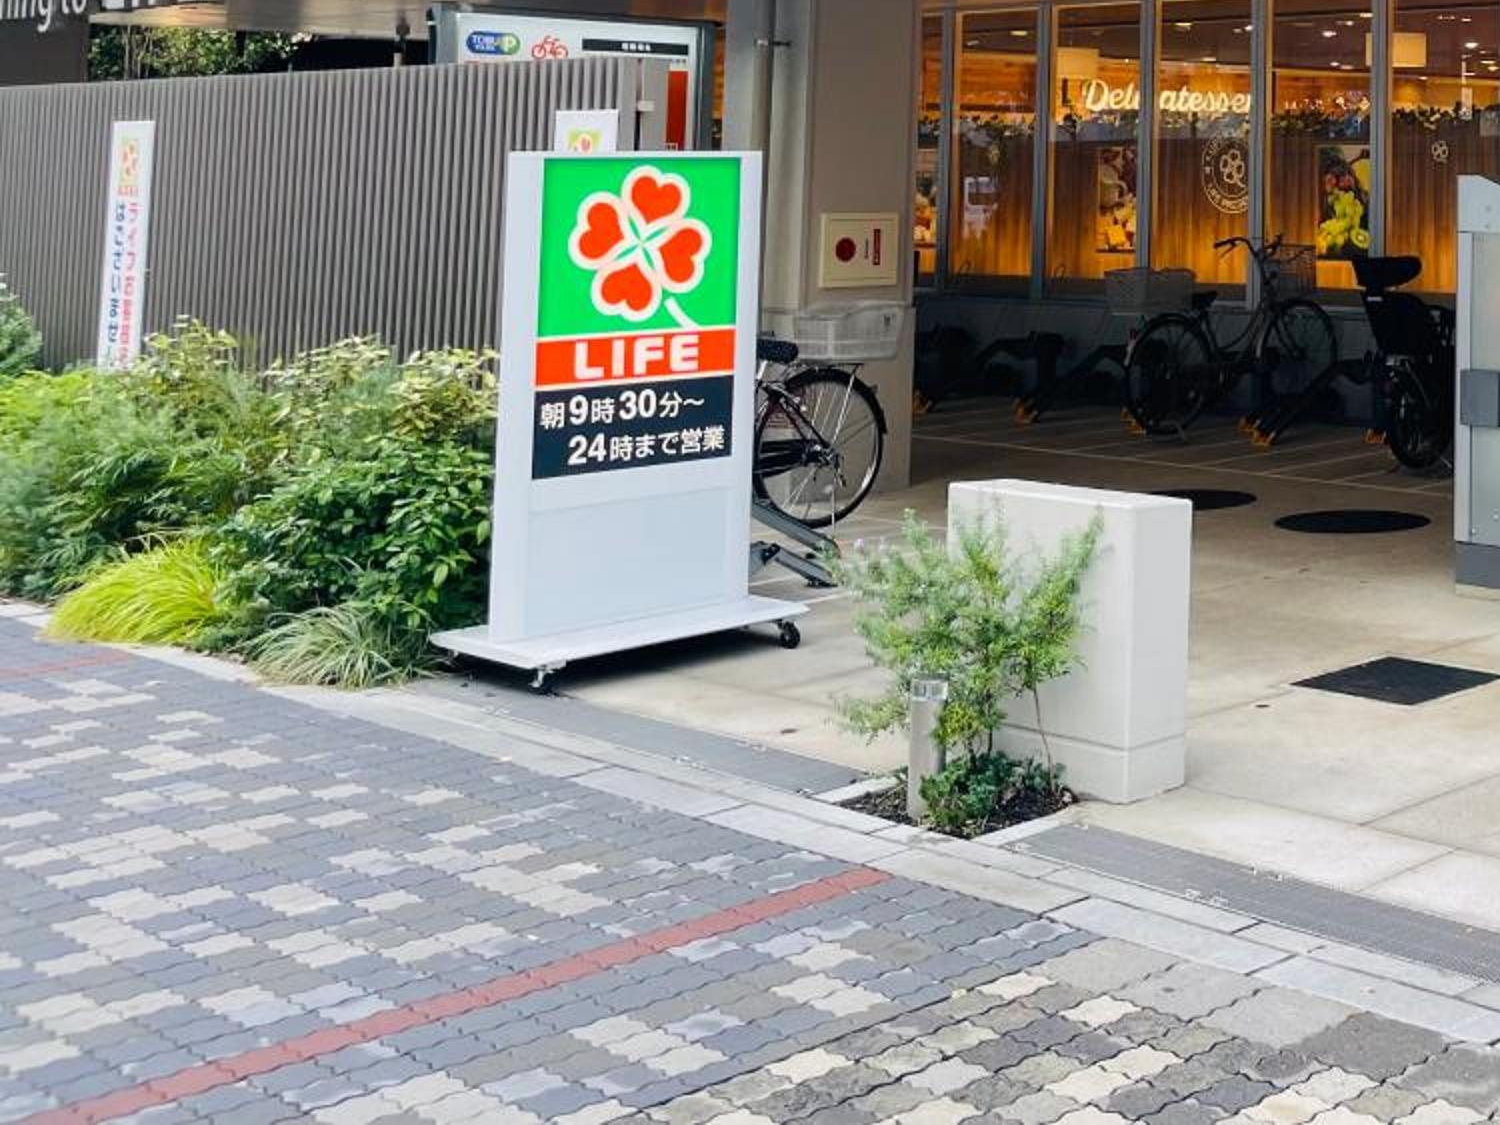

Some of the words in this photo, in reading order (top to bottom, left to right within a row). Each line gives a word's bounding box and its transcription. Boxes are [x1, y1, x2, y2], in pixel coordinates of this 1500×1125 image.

[1084, 78, 1250, 113] Deliatesse
[573, 334, 700, 380] LIFE
[567, 424, 726, 466] 24時まで営業
